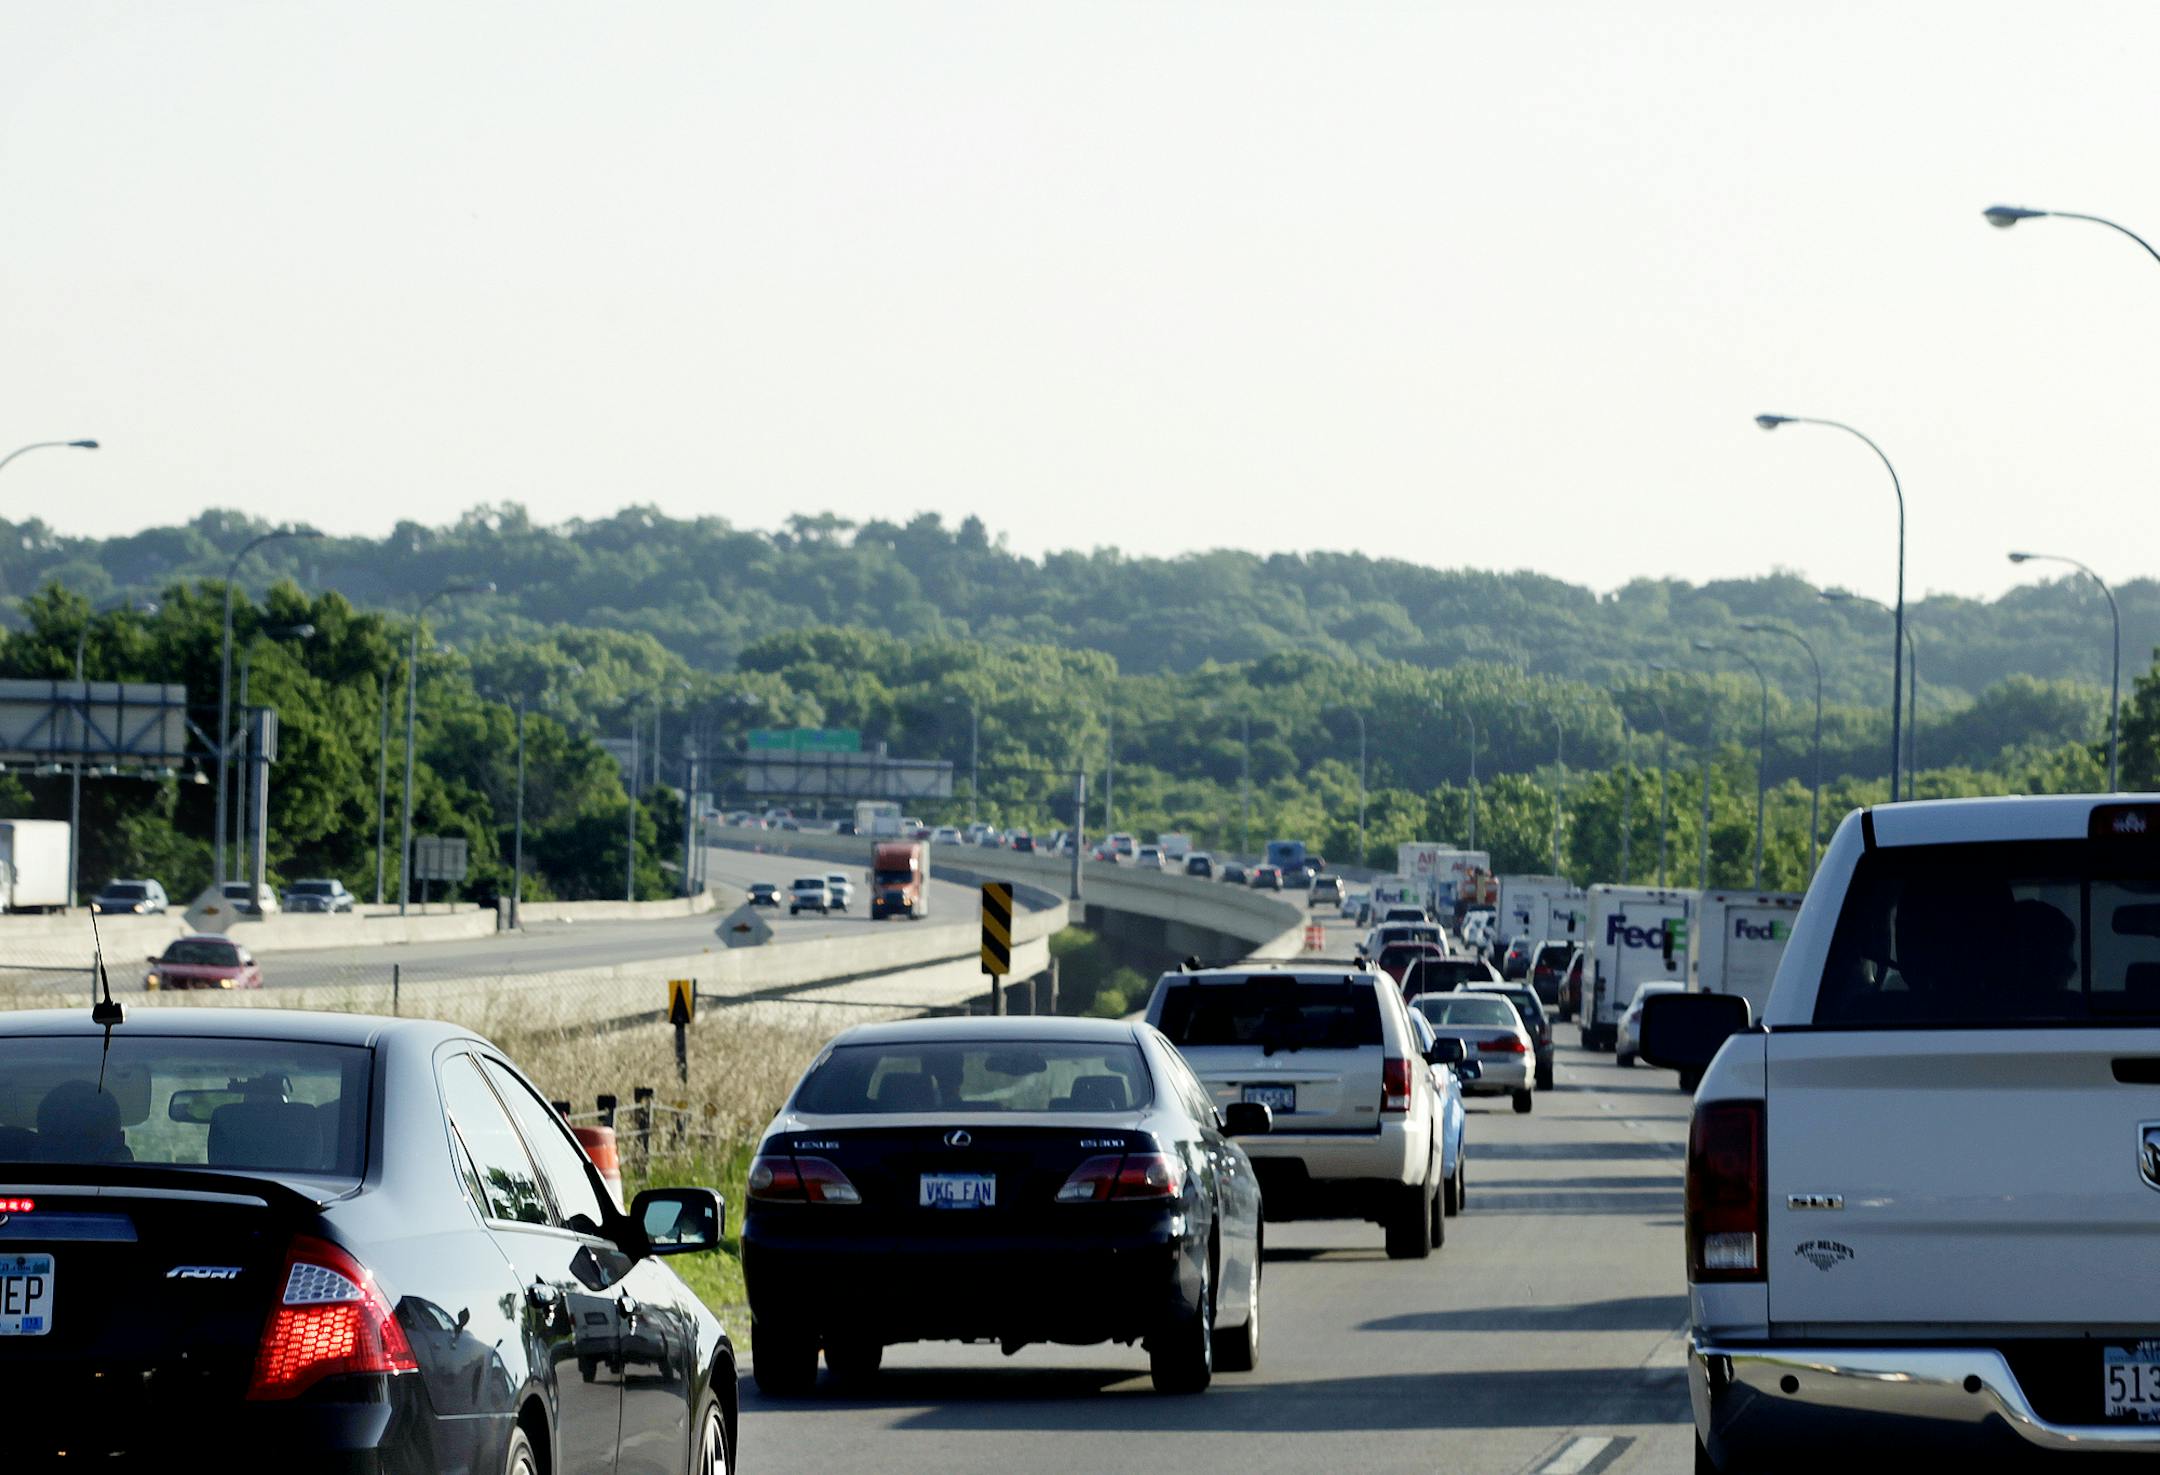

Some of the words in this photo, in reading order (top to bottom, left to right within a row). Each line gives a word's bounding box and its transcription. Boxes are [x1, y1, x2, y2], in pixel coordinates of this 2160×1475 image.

[1606, 914, 1688, 951] FedE
[1735, 918, 1793, 942] FedE
[793, 1140, 840, 1149] LEXUS
[963, 1181, 991, 1201] FAN
[165, 1265, 243, 1280] SPORT
[0, 1275, 43, 1315] EP
